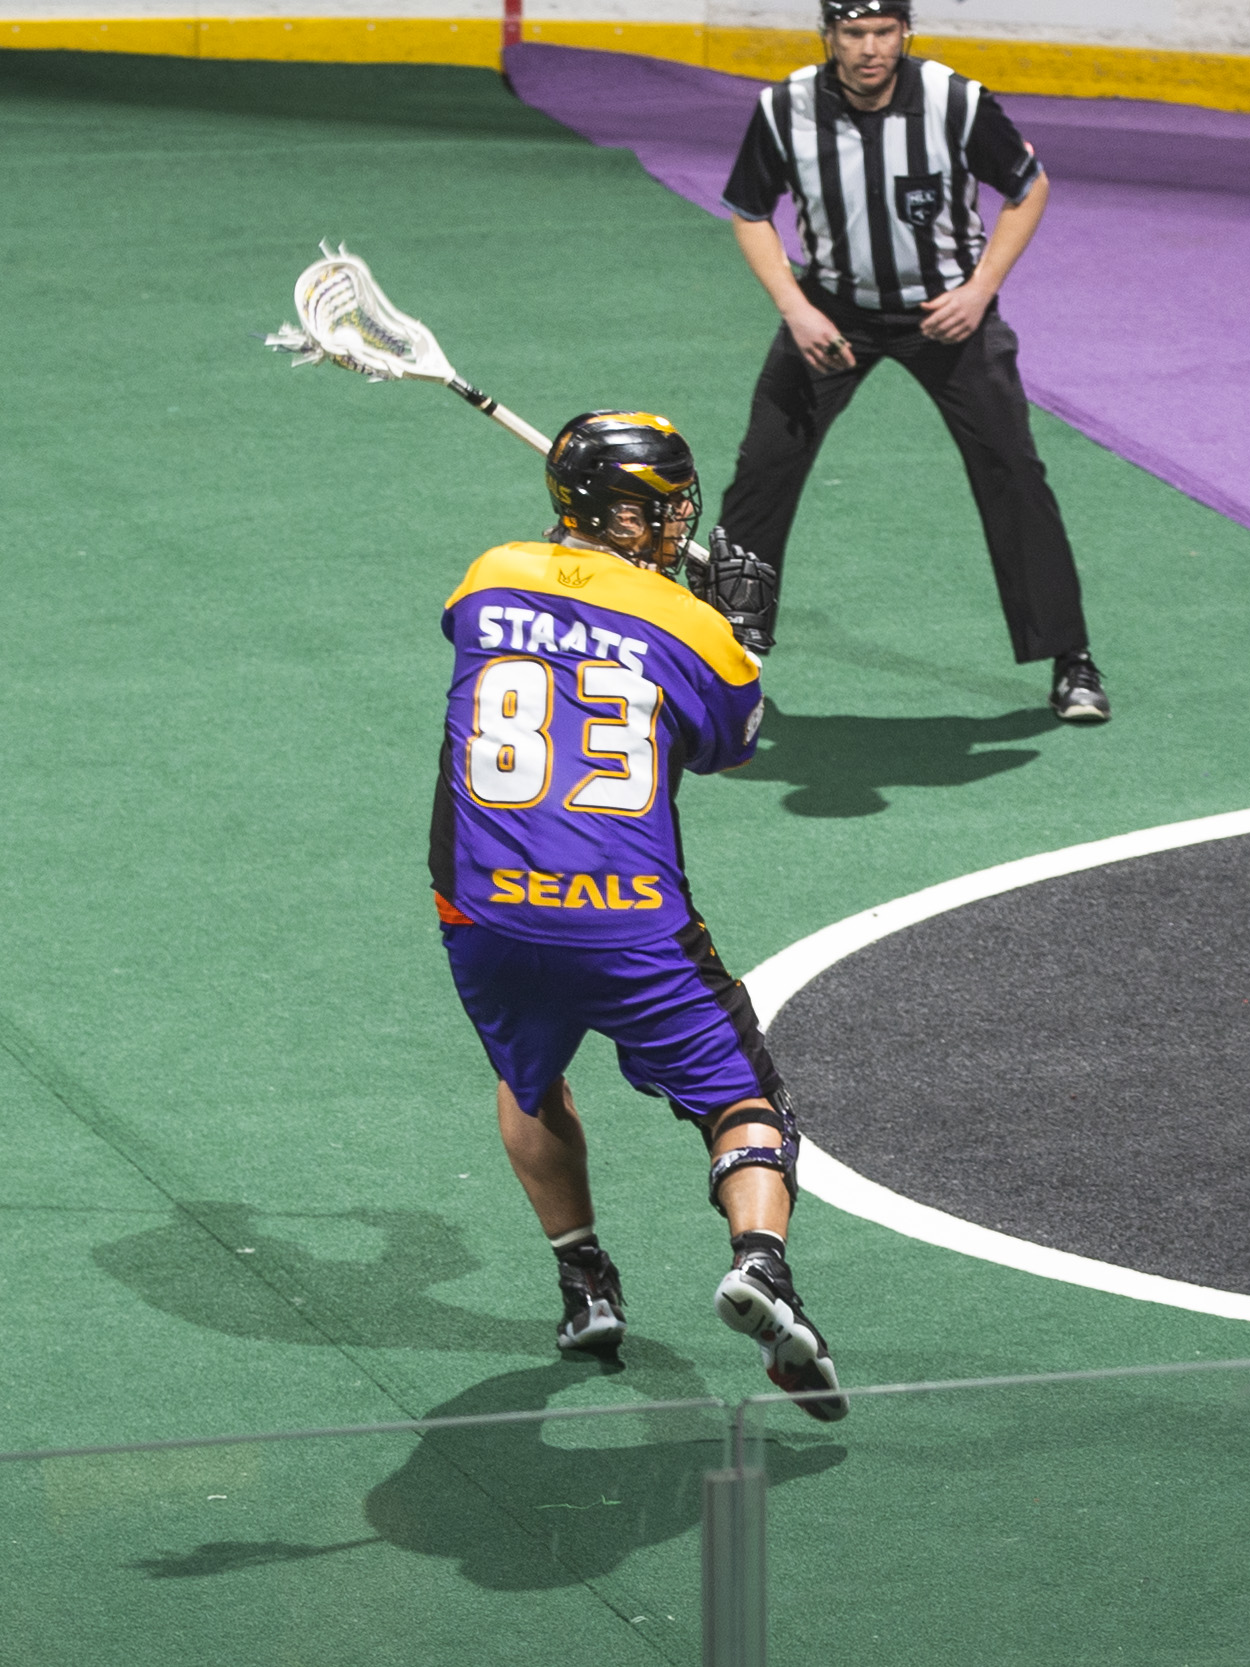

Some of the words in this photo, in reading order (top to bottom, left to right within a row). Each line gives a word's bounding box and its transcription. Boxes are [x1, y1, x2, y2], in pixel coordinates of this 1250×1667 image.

[478, 606, 648, 677] STAATS
[466, 655, 664, 817] 83
[489, 869, 664, 911] SEALS
